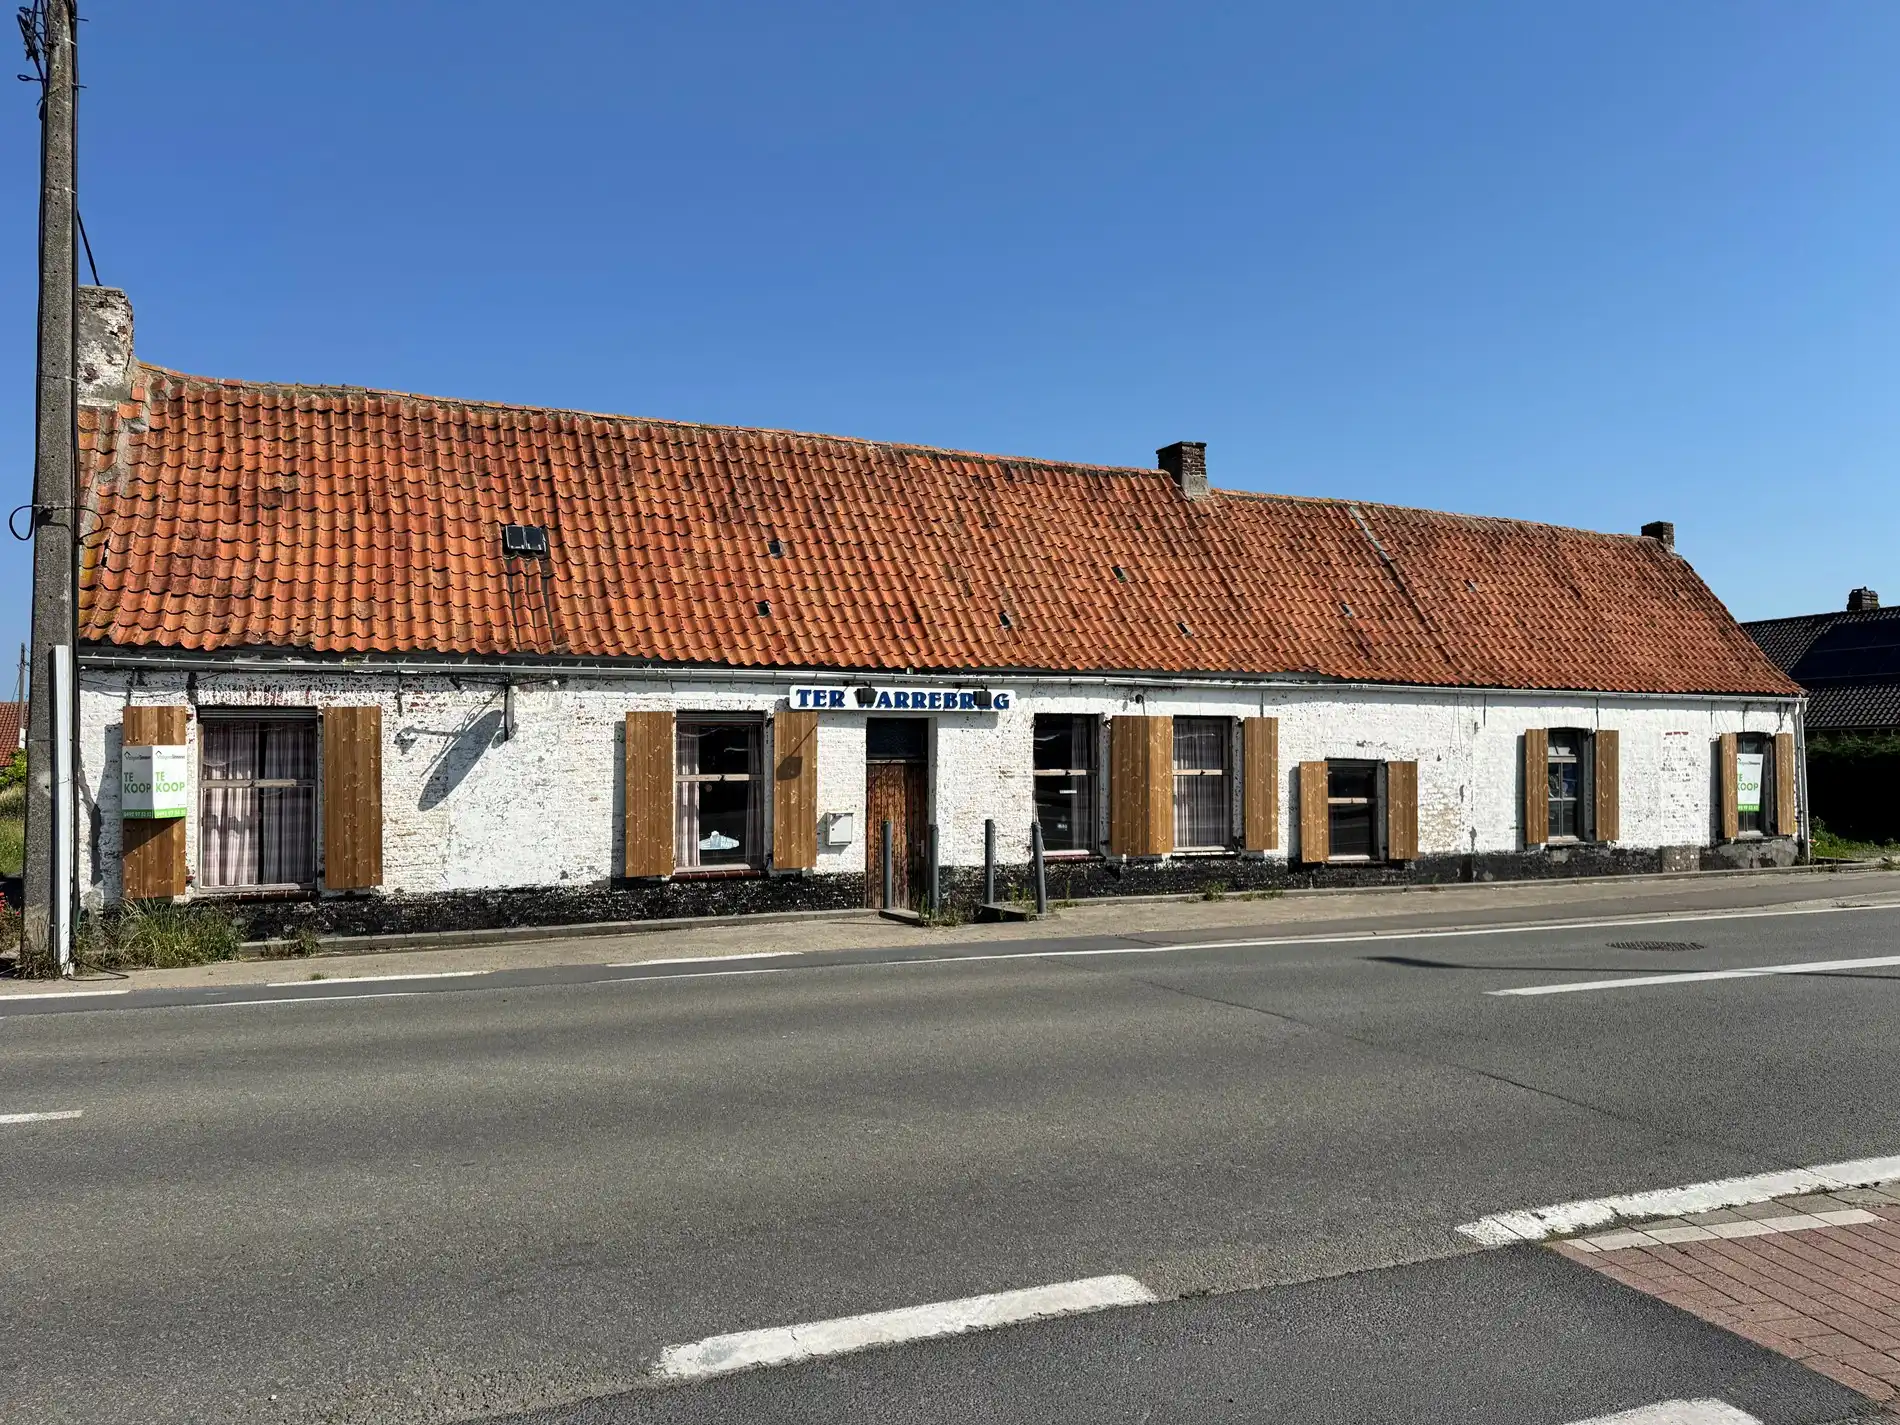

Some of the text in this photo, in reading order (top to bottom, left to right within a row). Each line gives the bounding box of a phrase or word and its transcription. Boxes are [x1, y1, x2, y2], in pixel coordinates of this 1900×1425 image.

[796, 689, 1010, 710] TER ARREBRG
[124, 772, 134, 782] TE
[155, 771, 165, 781] TE
[124, 782, 152, 793] KOOP
[155, 781, 185, 792] KOOP
